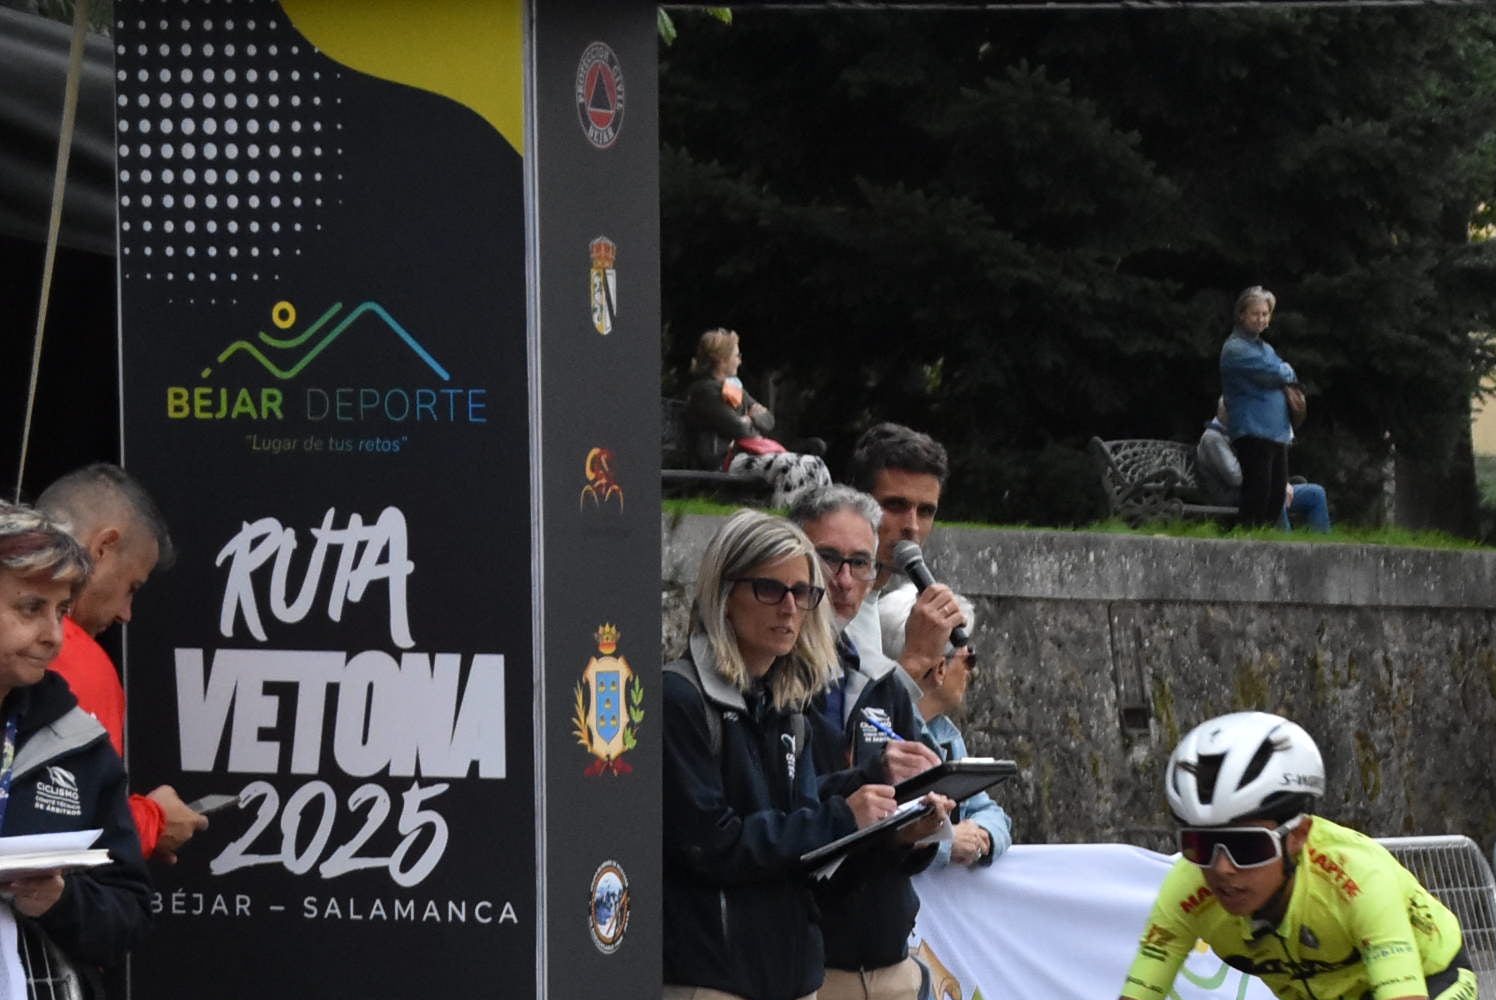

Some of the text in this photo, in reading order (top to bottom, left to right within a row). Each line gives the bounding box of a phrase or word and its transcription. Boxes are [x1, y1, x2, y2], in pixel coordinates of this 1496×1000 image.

[306, 387, 487, 423] DEPORTE
[303, 435, 324, 452] de
[328, 436, 353, 452] tus
[215, 506, 416, 649] RUTA
[174, 647, 507, 780] VETONA
[210, 779, 451, 888] 2025
[303, 895, 519, 925] SALAMANCA
